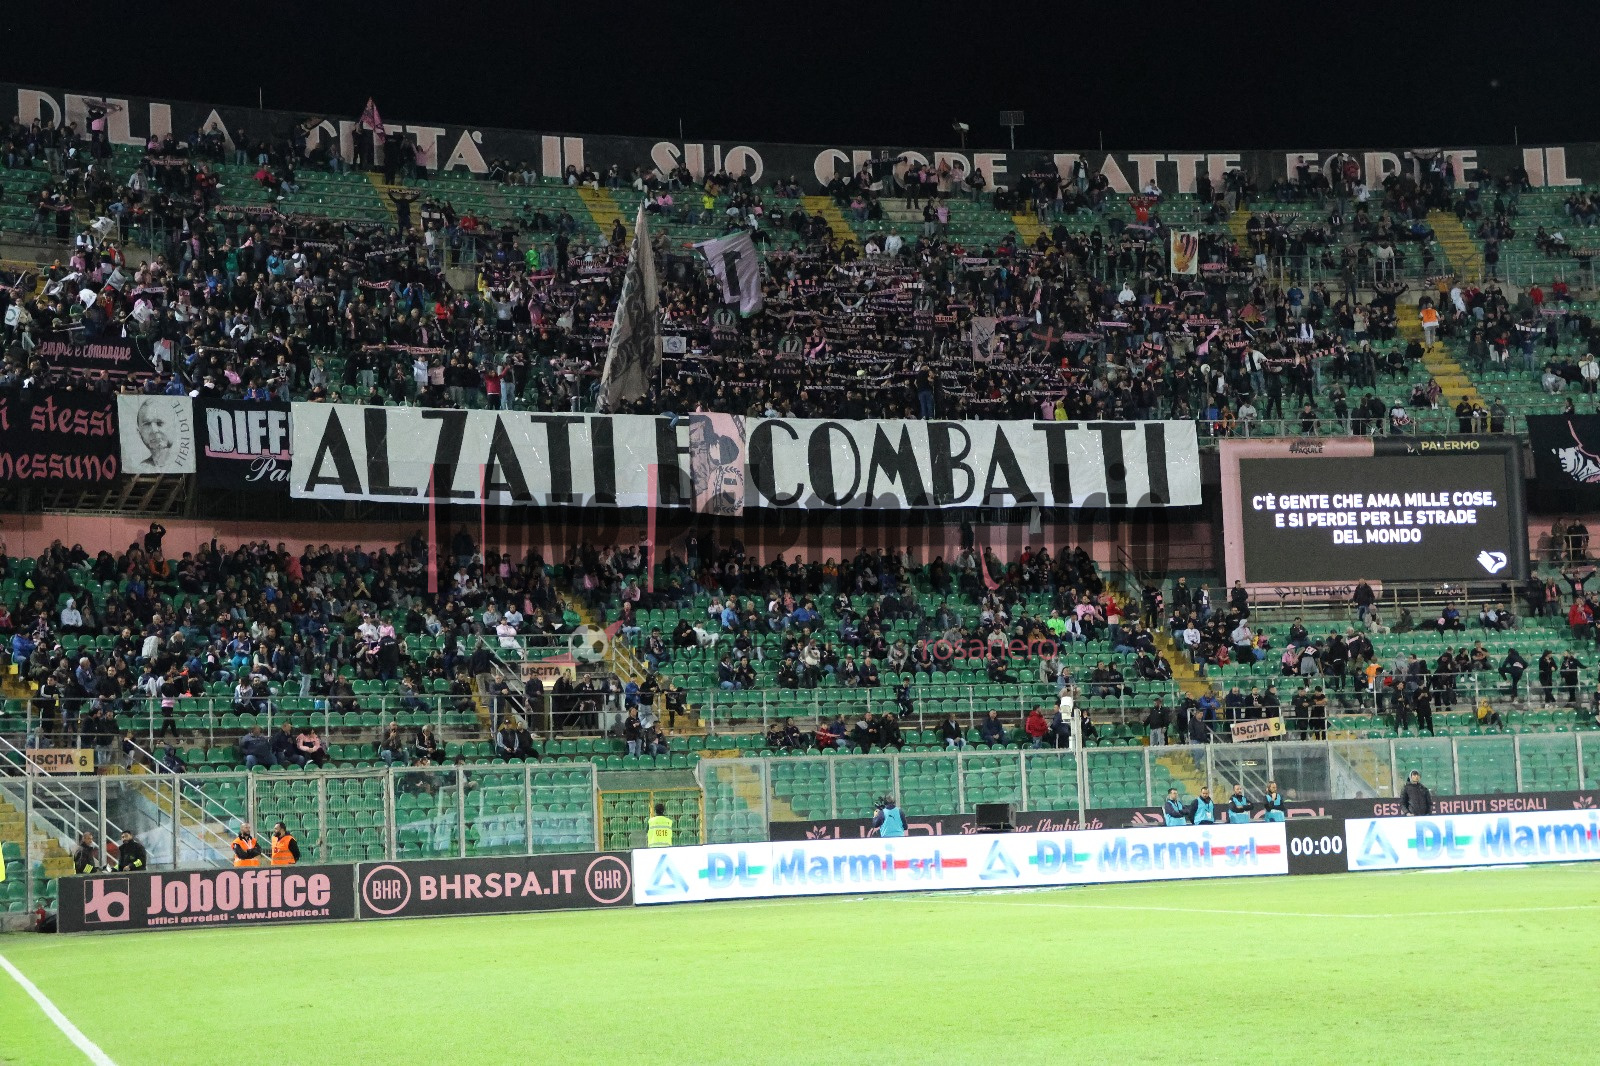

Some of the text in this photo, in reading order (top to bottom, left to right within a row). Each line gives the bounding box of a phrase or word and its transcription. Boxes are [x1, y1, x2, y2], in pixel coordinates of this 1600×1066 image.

[651, 141, 763, 186] SUO
[1523, 147, 1582, 187] IL
[0, 395, 115, 437] i stessi
[179, 418, 190, 433] DI
[205, 407, 292, 455] DIFF
[174, 437, 190, 467] FIERI
[304, 406, 616, 502] ALZATI
[748, 419, 1171, 507] COMBATTI
[1421, 440, 1480, 451] PALERMO
[0, 452, 118, 482] nessuno
[1252, 491, 1497, 511] C'È GENTE CHE AMA MILLE COSE,
[1275, 509, 1477, 528] E SI PERDE PER LE STRADE
[1333, 528, 1422, 544] DEL MONDO
[521, 667, 560, 677] USCITA
[1232, 722, 1281, 736] USCITA 9
[27, 753, 88, 766] USCITA 6
[1440, 800, 1486, 814] RIFIUTI
[1490, 798, 1547, 812] SPECIALI
[1036, 829, 1260, 875] DL Marmi srl
[1290, 836, 1342, 856] 00:00
[1415, 819, 1466, 861] DL
[706, 842, 943, 889] DL Marmi srl
[147, 869, 331, 915] JobOffice
[372, 869, 622, 901] BHR BHRSPA.IT BHR
[147, 914, 178, 926] uffici
[180, 912, 229, 924] arredati
[237, 908, 331, 920] www.joboffice.it
